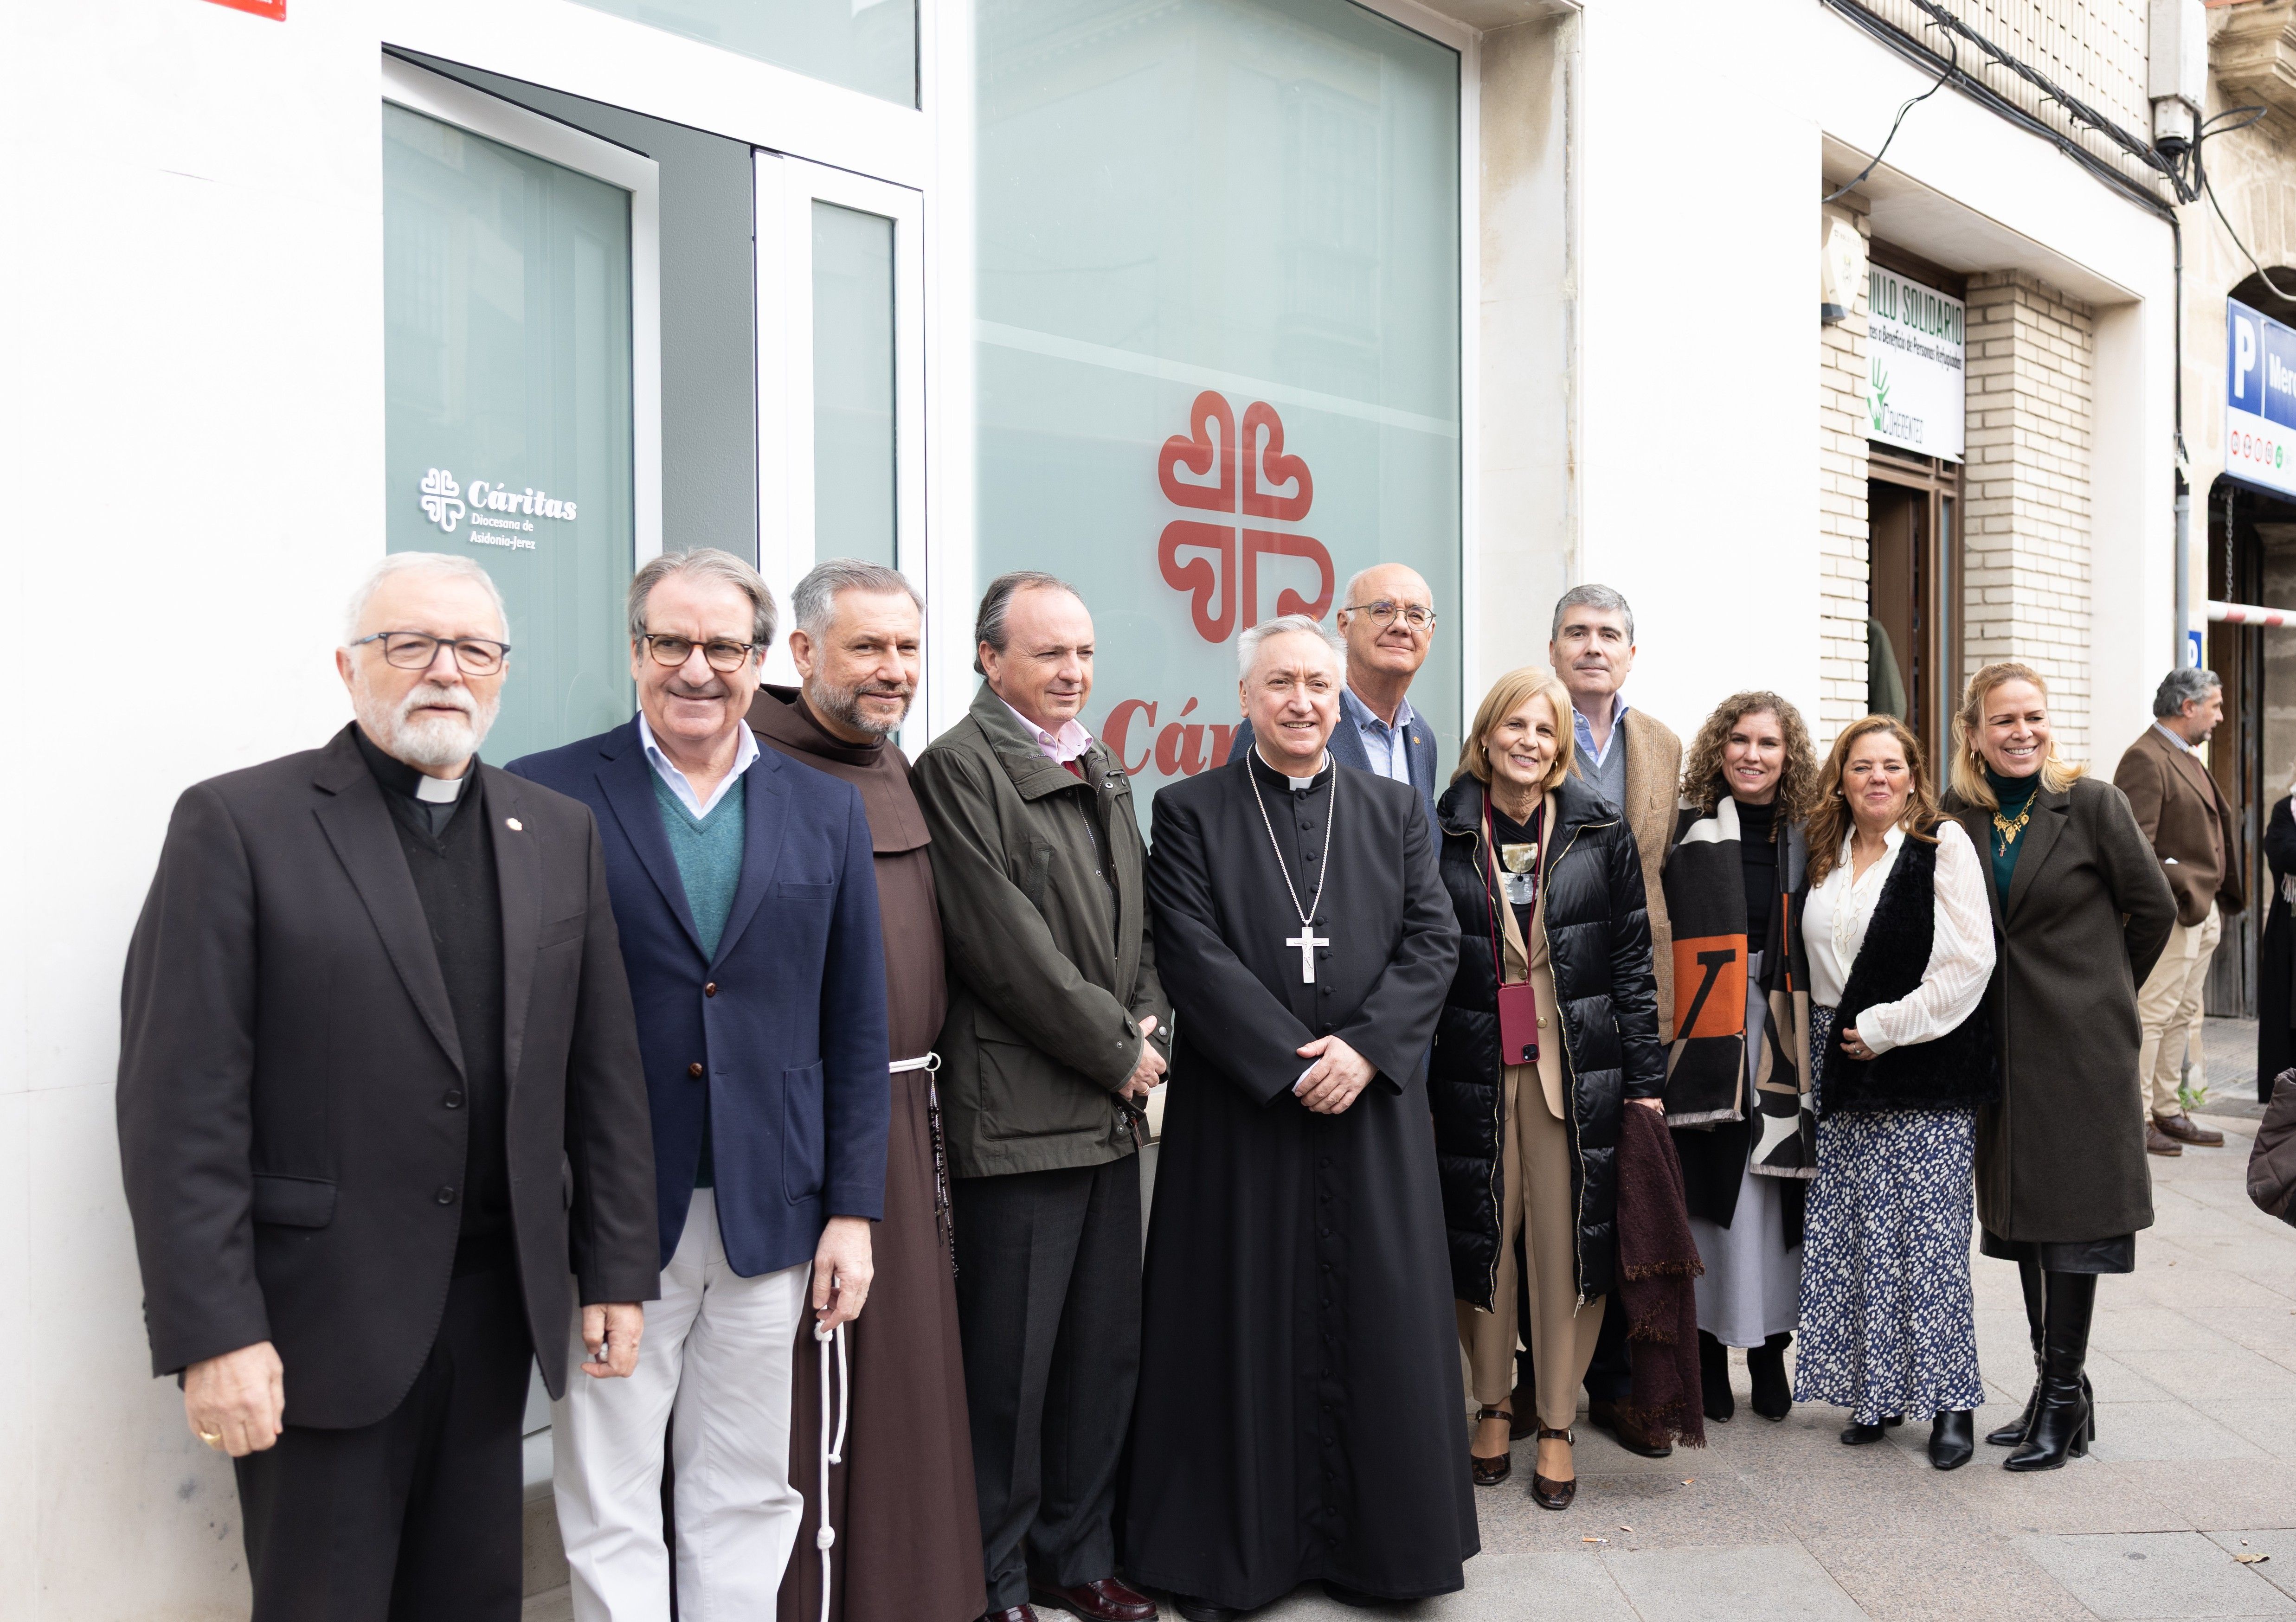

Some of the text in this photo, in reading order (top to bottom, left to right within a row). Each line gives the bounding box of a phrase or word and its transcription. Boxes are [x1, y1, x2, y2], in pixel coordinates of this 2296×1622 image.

[1903, 284, 1962, 346] SOLIDARIO
[1883, 324, 1906, 353] Beneficio
[1907, 333, 1912, 352] de
[1913, 336, 1935, 361] Personas
[1936, 344, 1962, 371] Refugiadas
[2234, 314, 2256, 399] P
[468, 480, 577, 520] Cáritas
[470, 531, 536, 550] Asidonia-Jerez
[471, 512, 534, 532] Diocesana de
